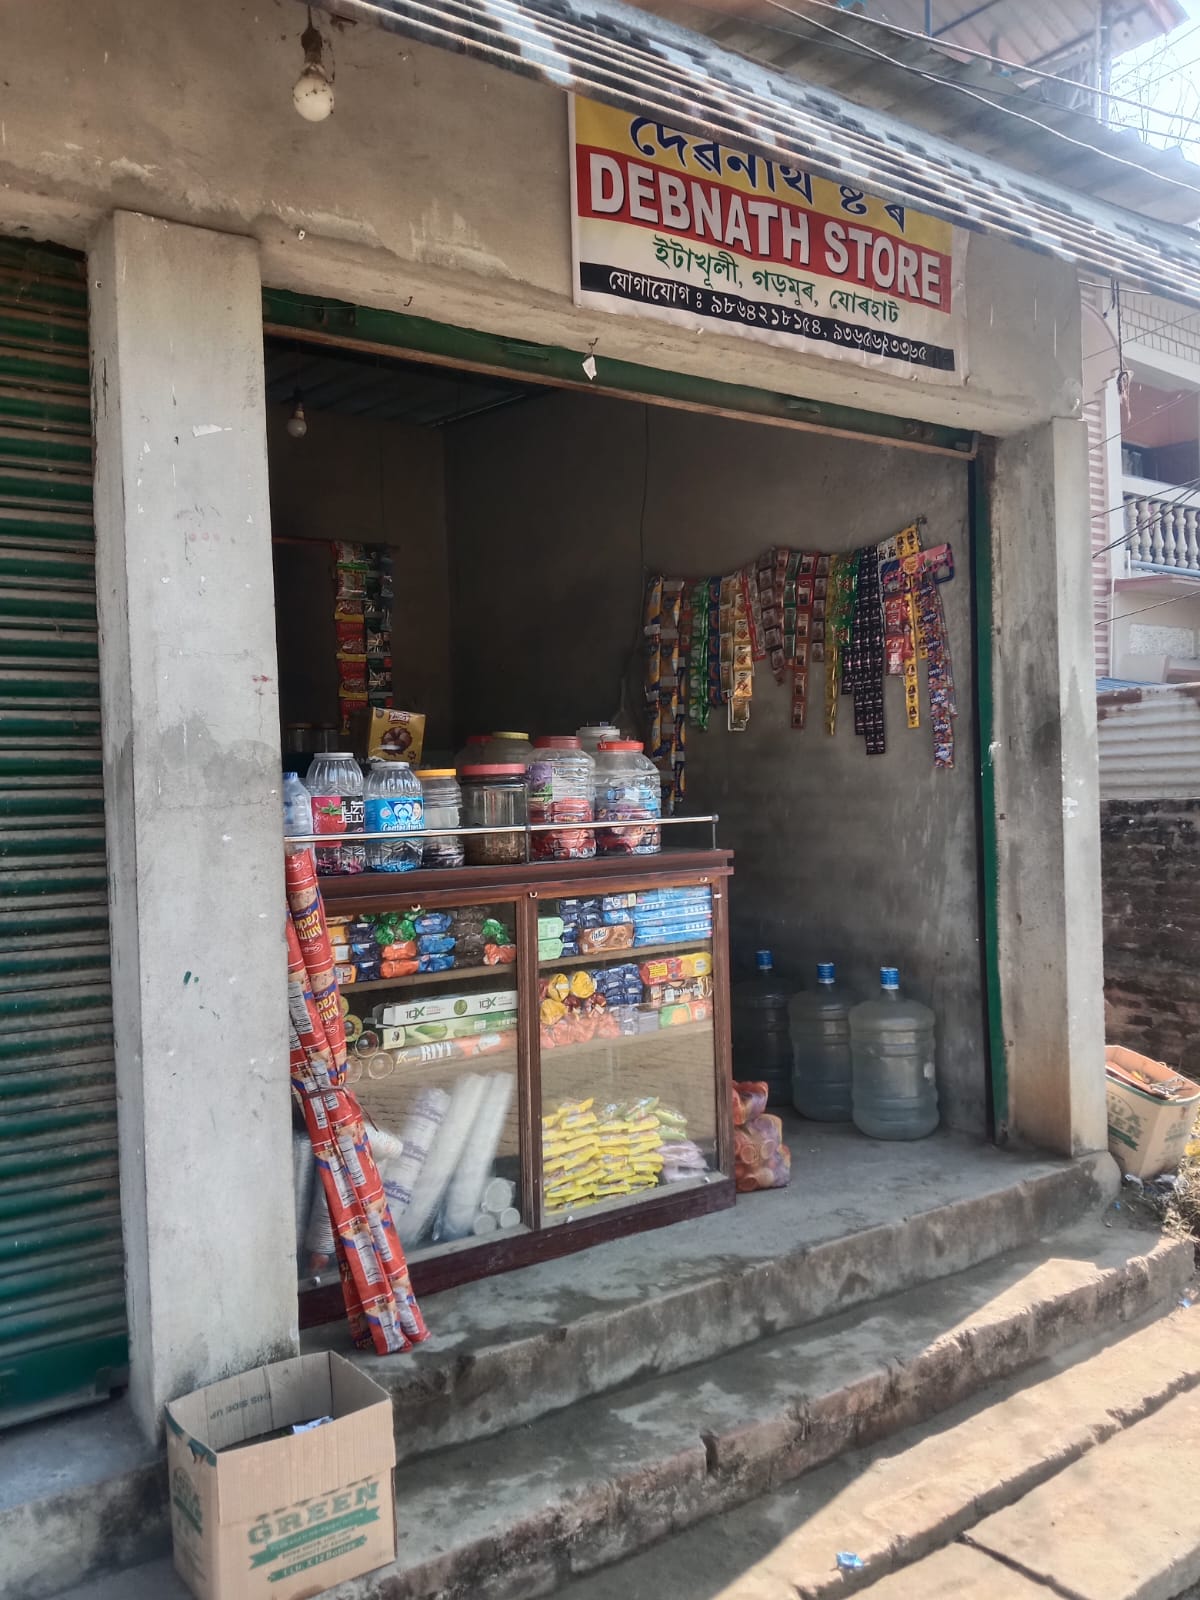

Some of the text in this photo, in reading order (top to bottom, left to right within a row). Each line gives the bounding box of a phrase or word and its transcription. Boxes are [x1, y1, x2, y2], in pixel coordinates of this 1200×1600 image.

[590, 152, 942, 305] DEBNATH STORE
[608, 270, 690, 305] যোগাযোগ
[248, 1481, 379, 1545] GREEN
